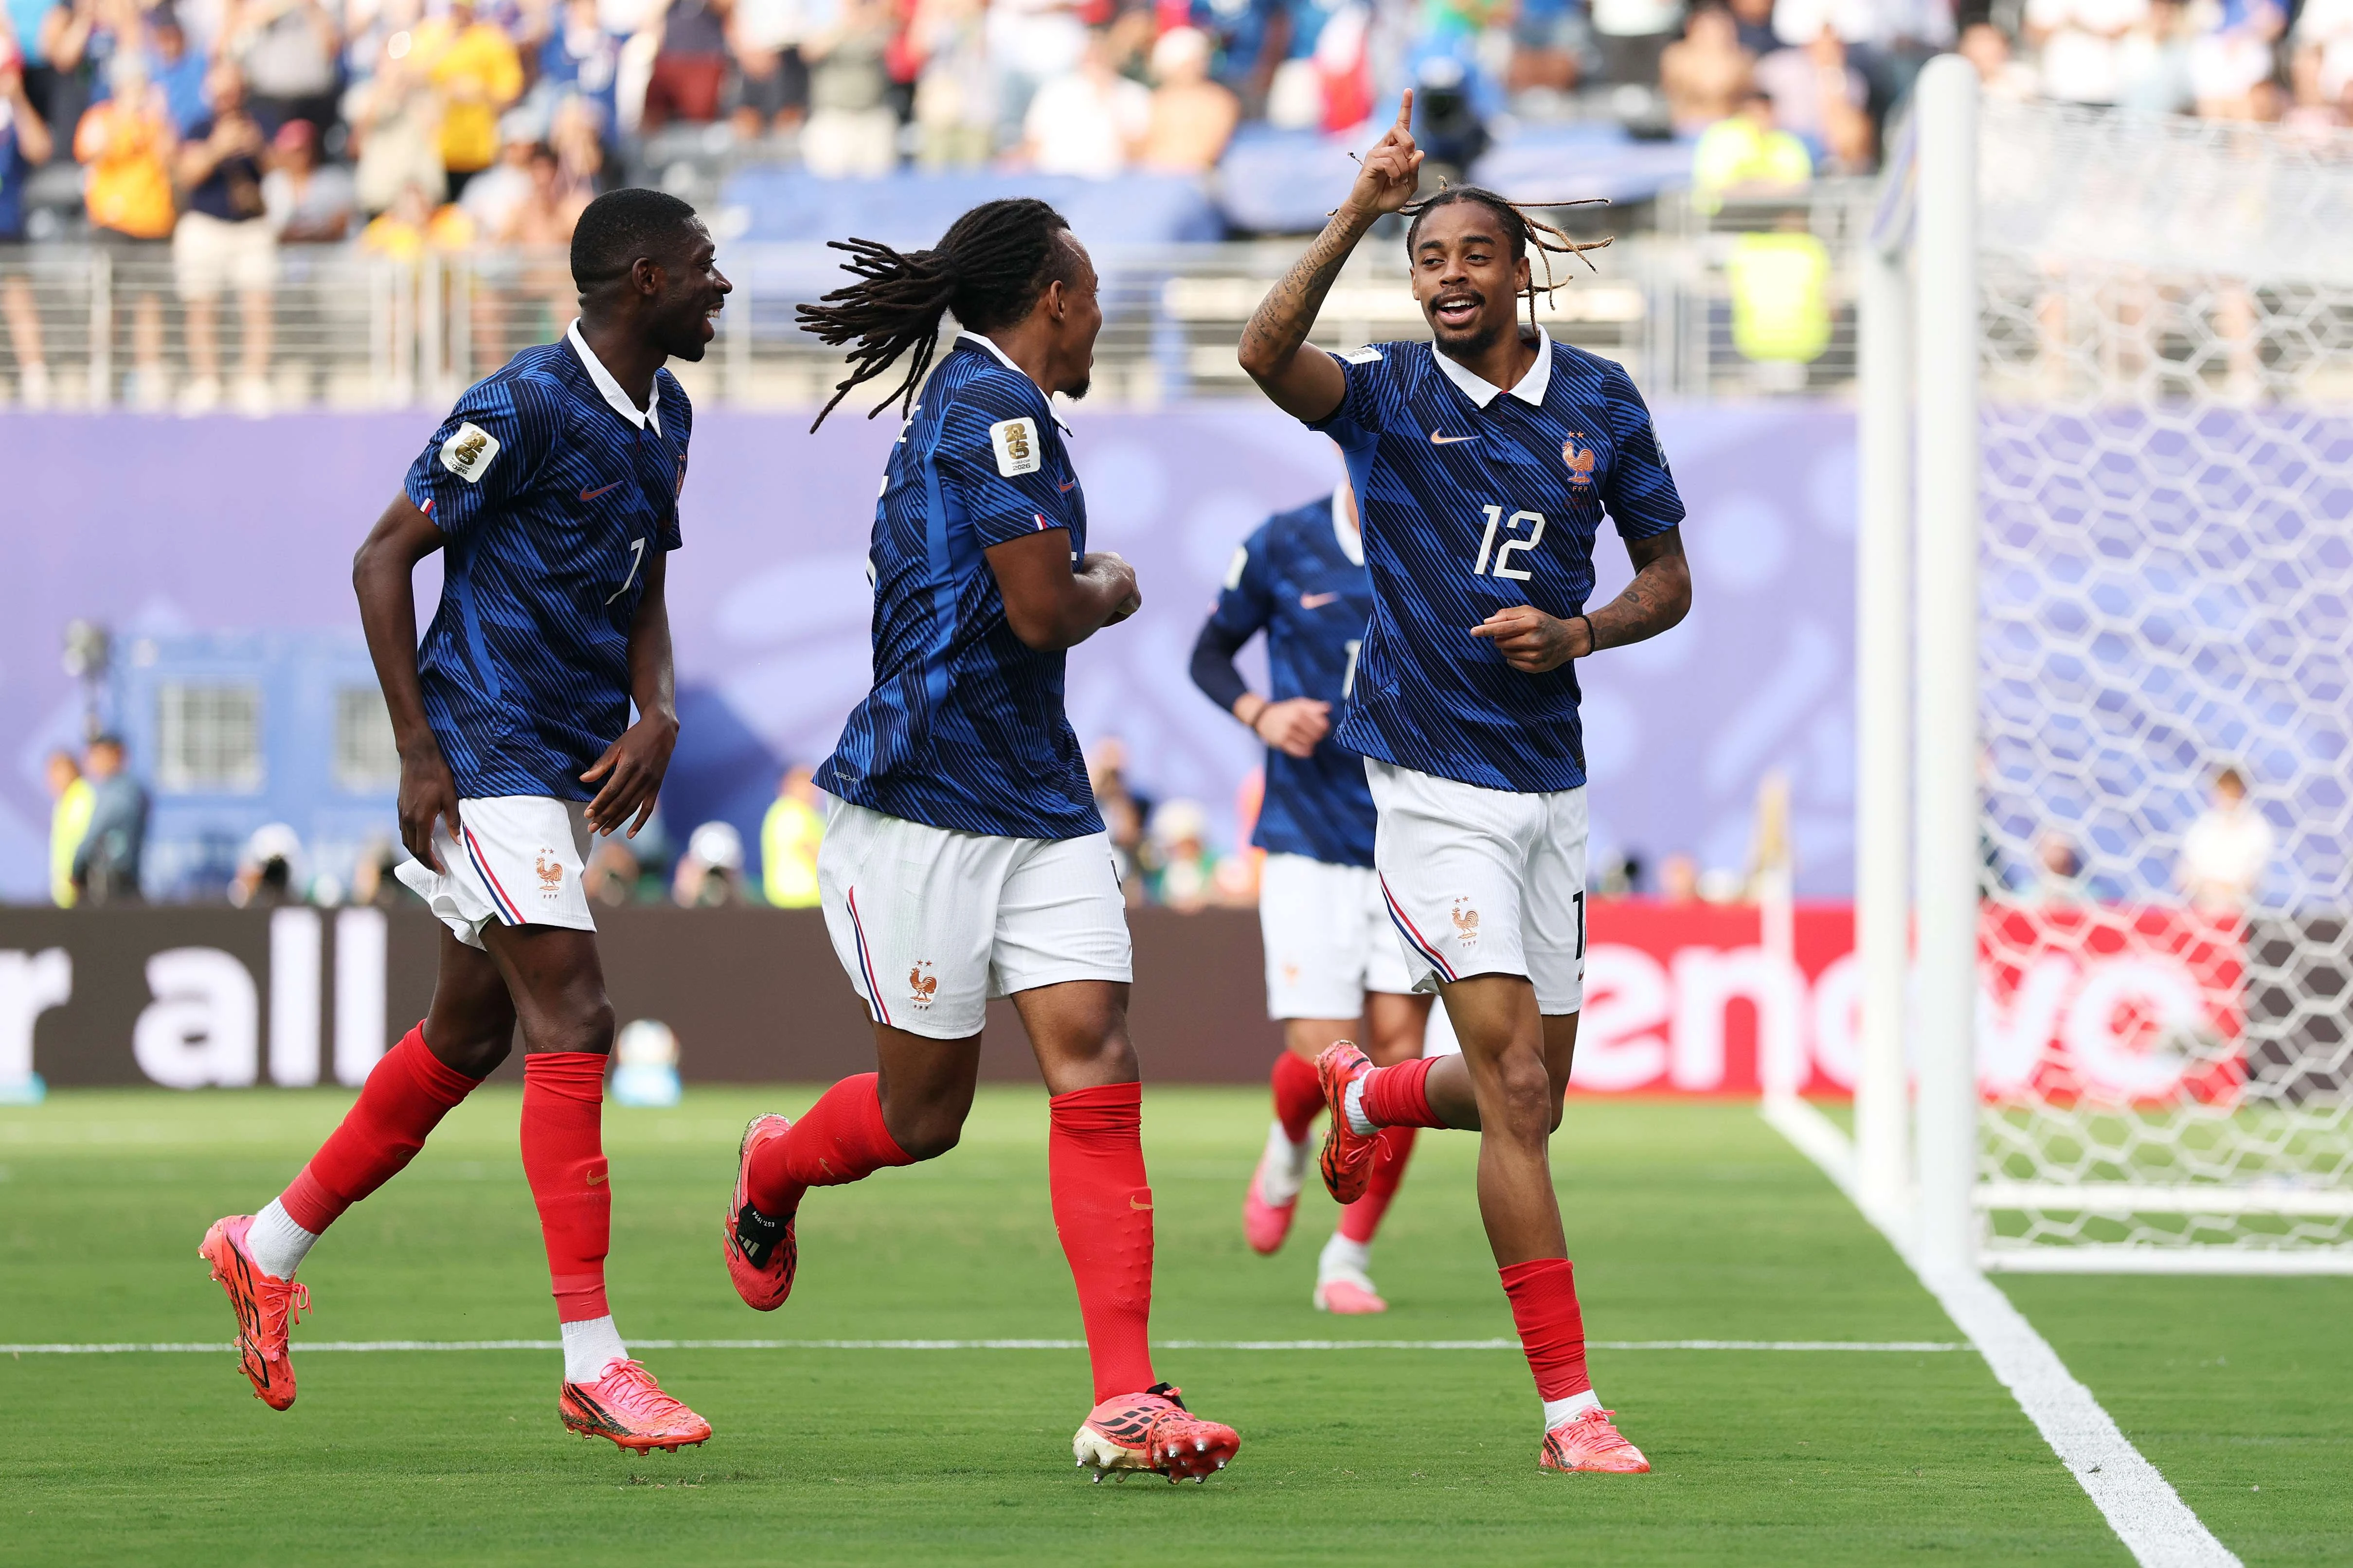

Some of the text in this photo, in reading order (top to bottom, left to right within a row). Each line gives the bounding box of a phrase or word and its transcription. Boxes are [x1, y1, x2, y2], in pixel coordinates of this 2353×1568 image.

[448, 459, 468, 475] 2026
[605, 537, 646, 605] 7
[1474, 504, 1545, 581] 12
[1573, 890, 1587, 960] 1
[133, 907, 388, 1088] all
